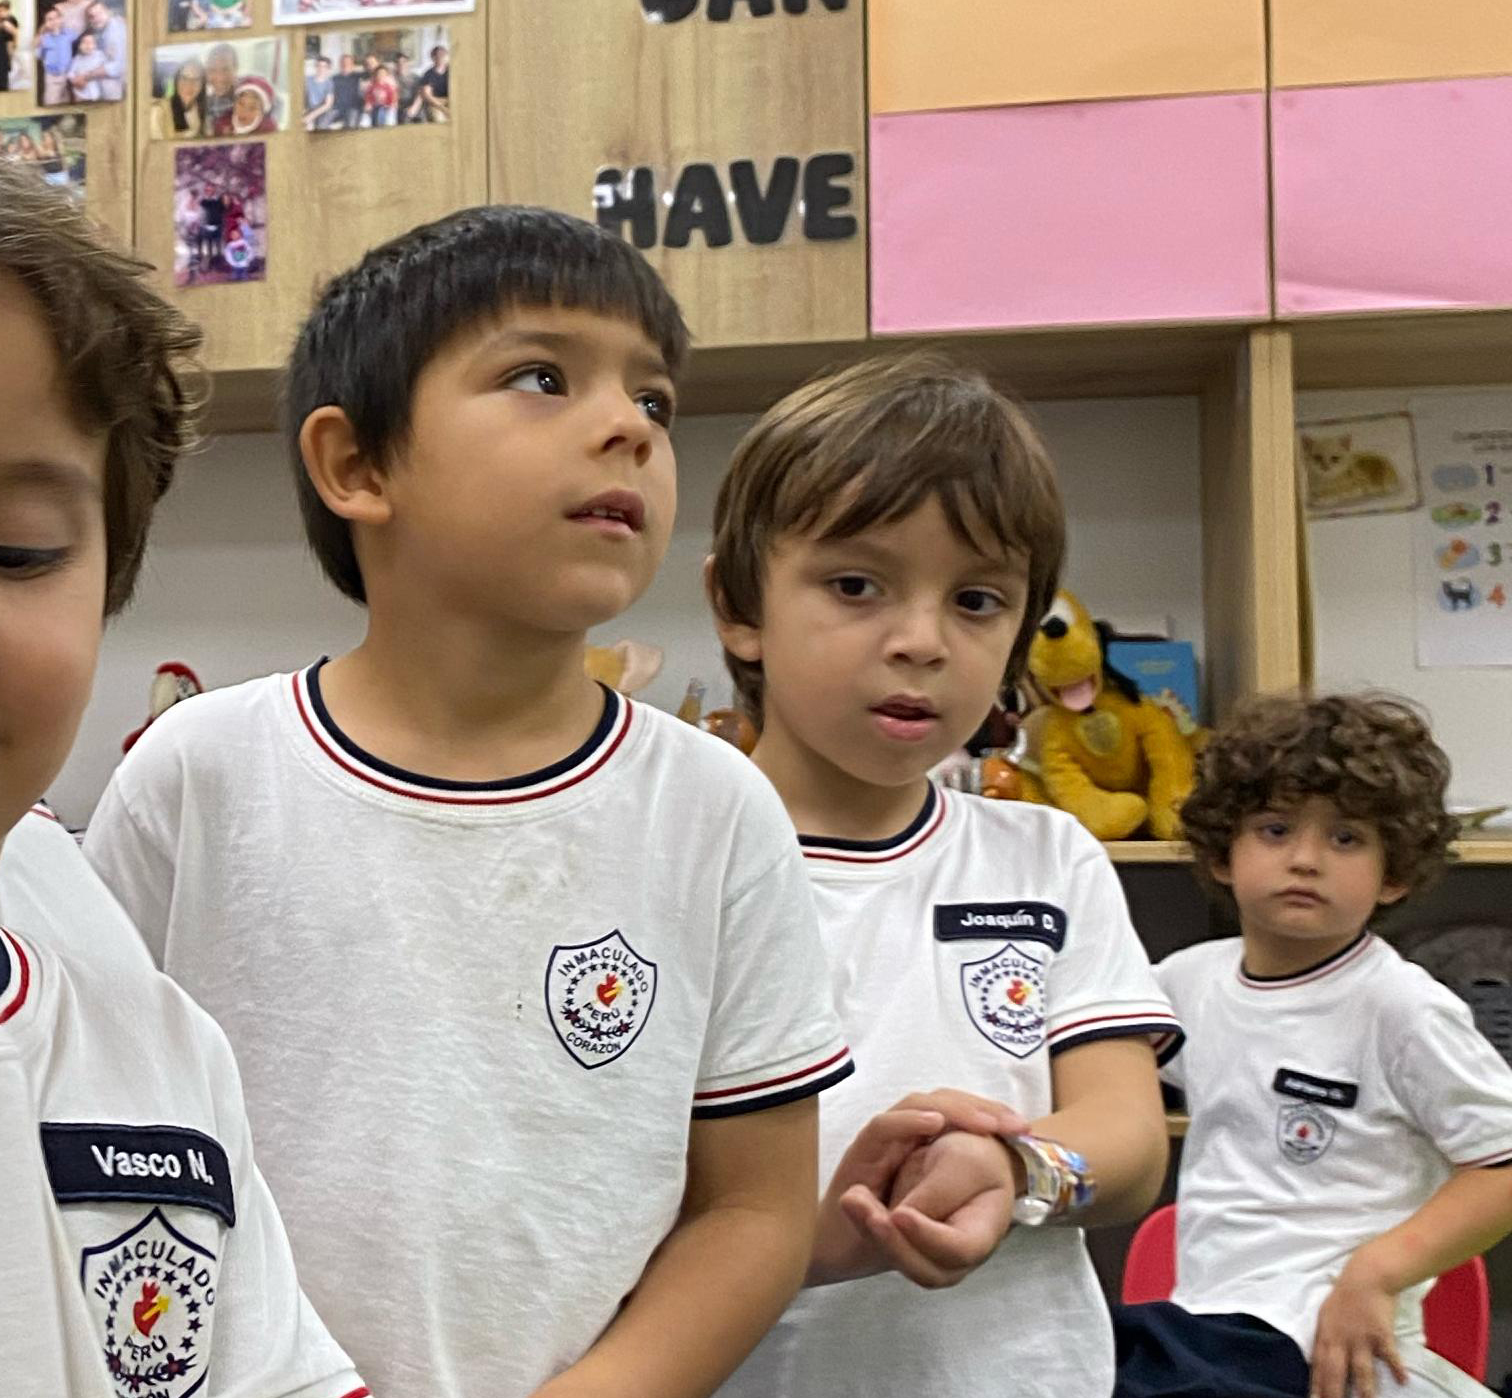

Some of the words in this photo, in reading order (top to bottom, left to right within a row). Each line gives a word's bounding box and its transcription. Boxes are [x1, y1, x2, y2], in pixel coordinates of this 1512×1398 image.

[593, 152, 857, 249] HAVE
[960, 909, 1035, 929] Joaquín
[558, 947, 649, 993] INMACULADO
[91, 1145, 182, 1178] Vasco
[187, 1148, 215, 1186] N.
[94, 1240, 215, 1306] INMACULADO
